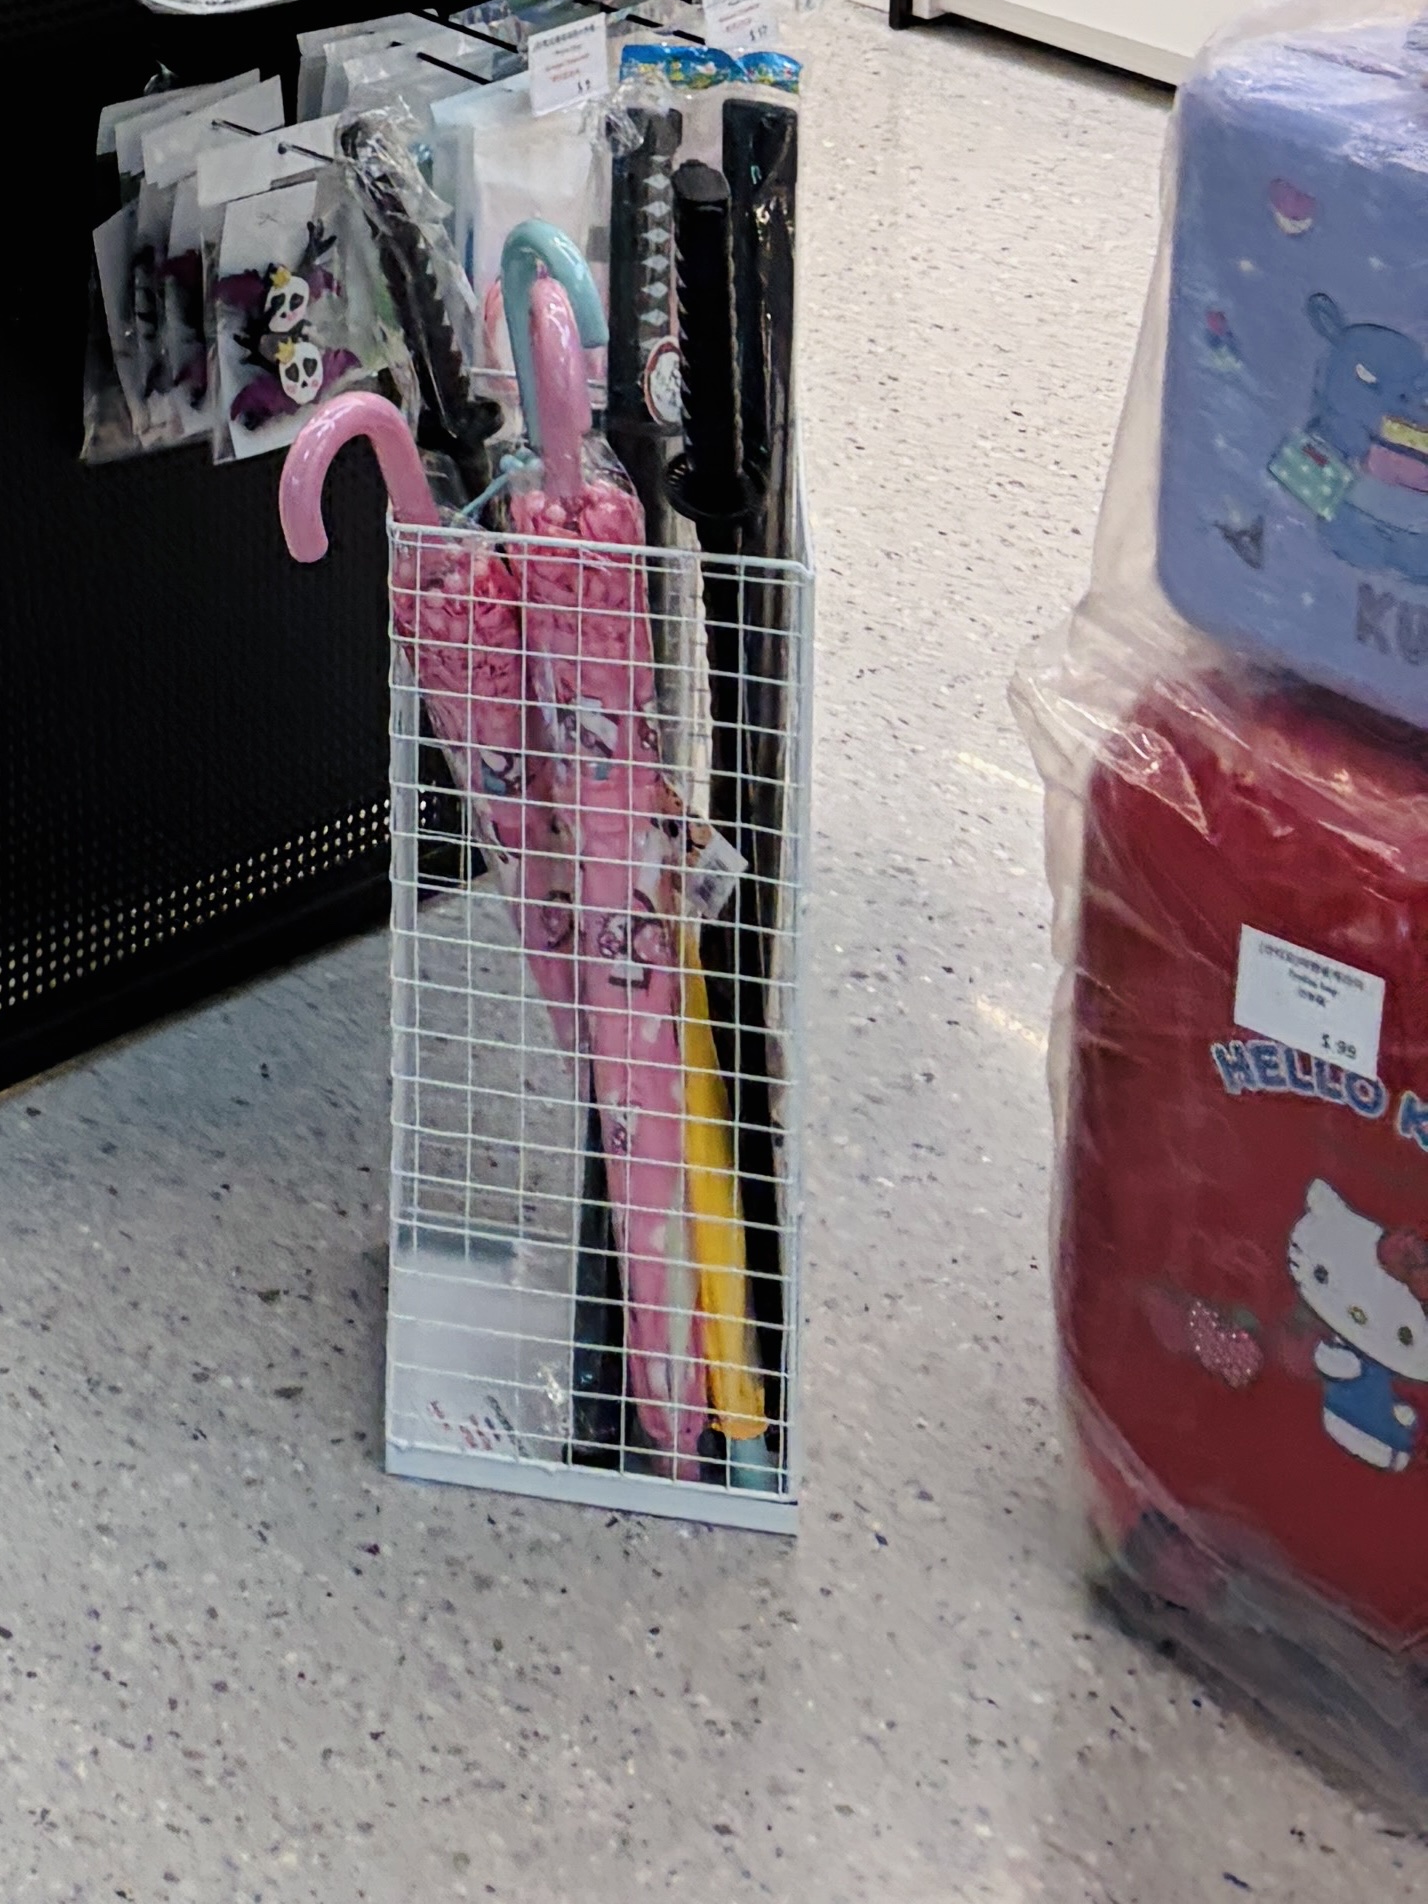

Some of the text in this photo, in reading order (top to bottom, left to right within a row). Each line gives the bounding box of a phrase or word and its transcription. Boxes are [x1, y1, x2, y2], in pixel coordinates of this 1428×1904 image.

[1321, 1033, 1357, 1060] $ 99
[1212, 1040, 1388, 1120] HELLO
